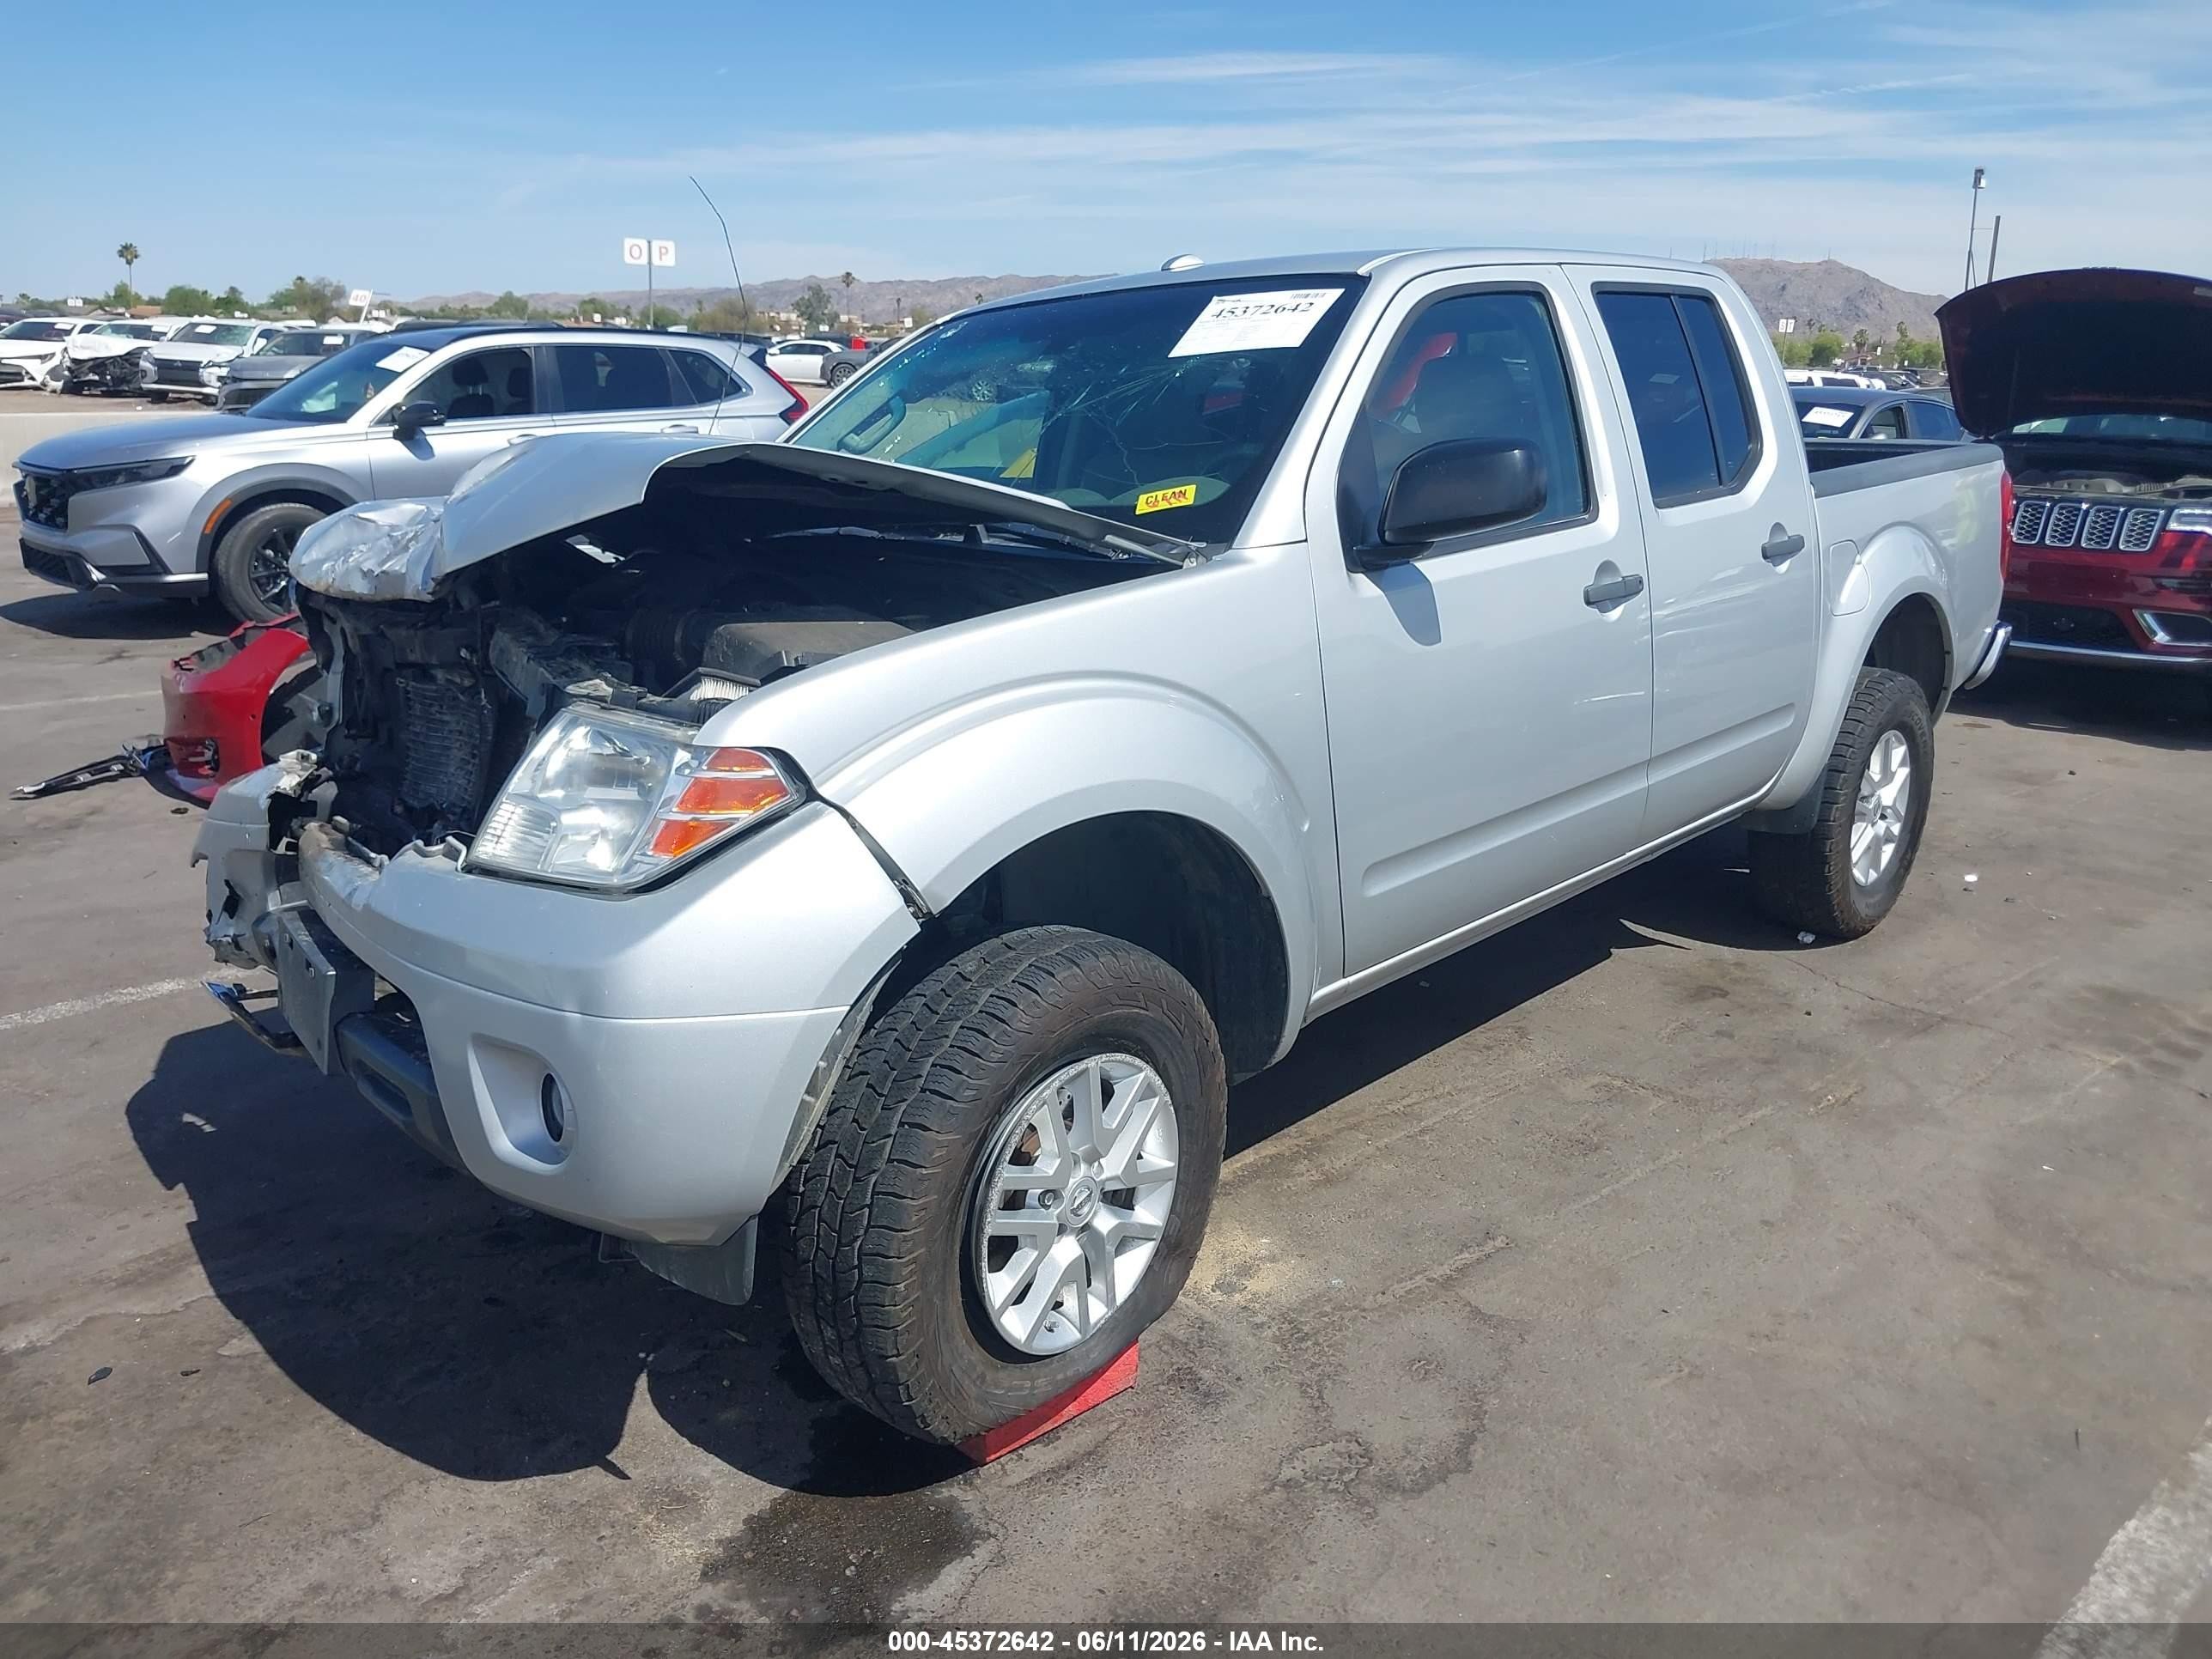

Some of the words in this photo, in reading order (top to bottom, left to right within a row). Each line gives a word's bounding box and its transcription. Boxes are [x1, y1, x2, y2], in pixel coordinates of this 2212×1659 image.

[659, 246, 669, 261] P
[1212, 301, 1315, 319] 45372642
[1145, 489, 1188, 505] CLEAN
